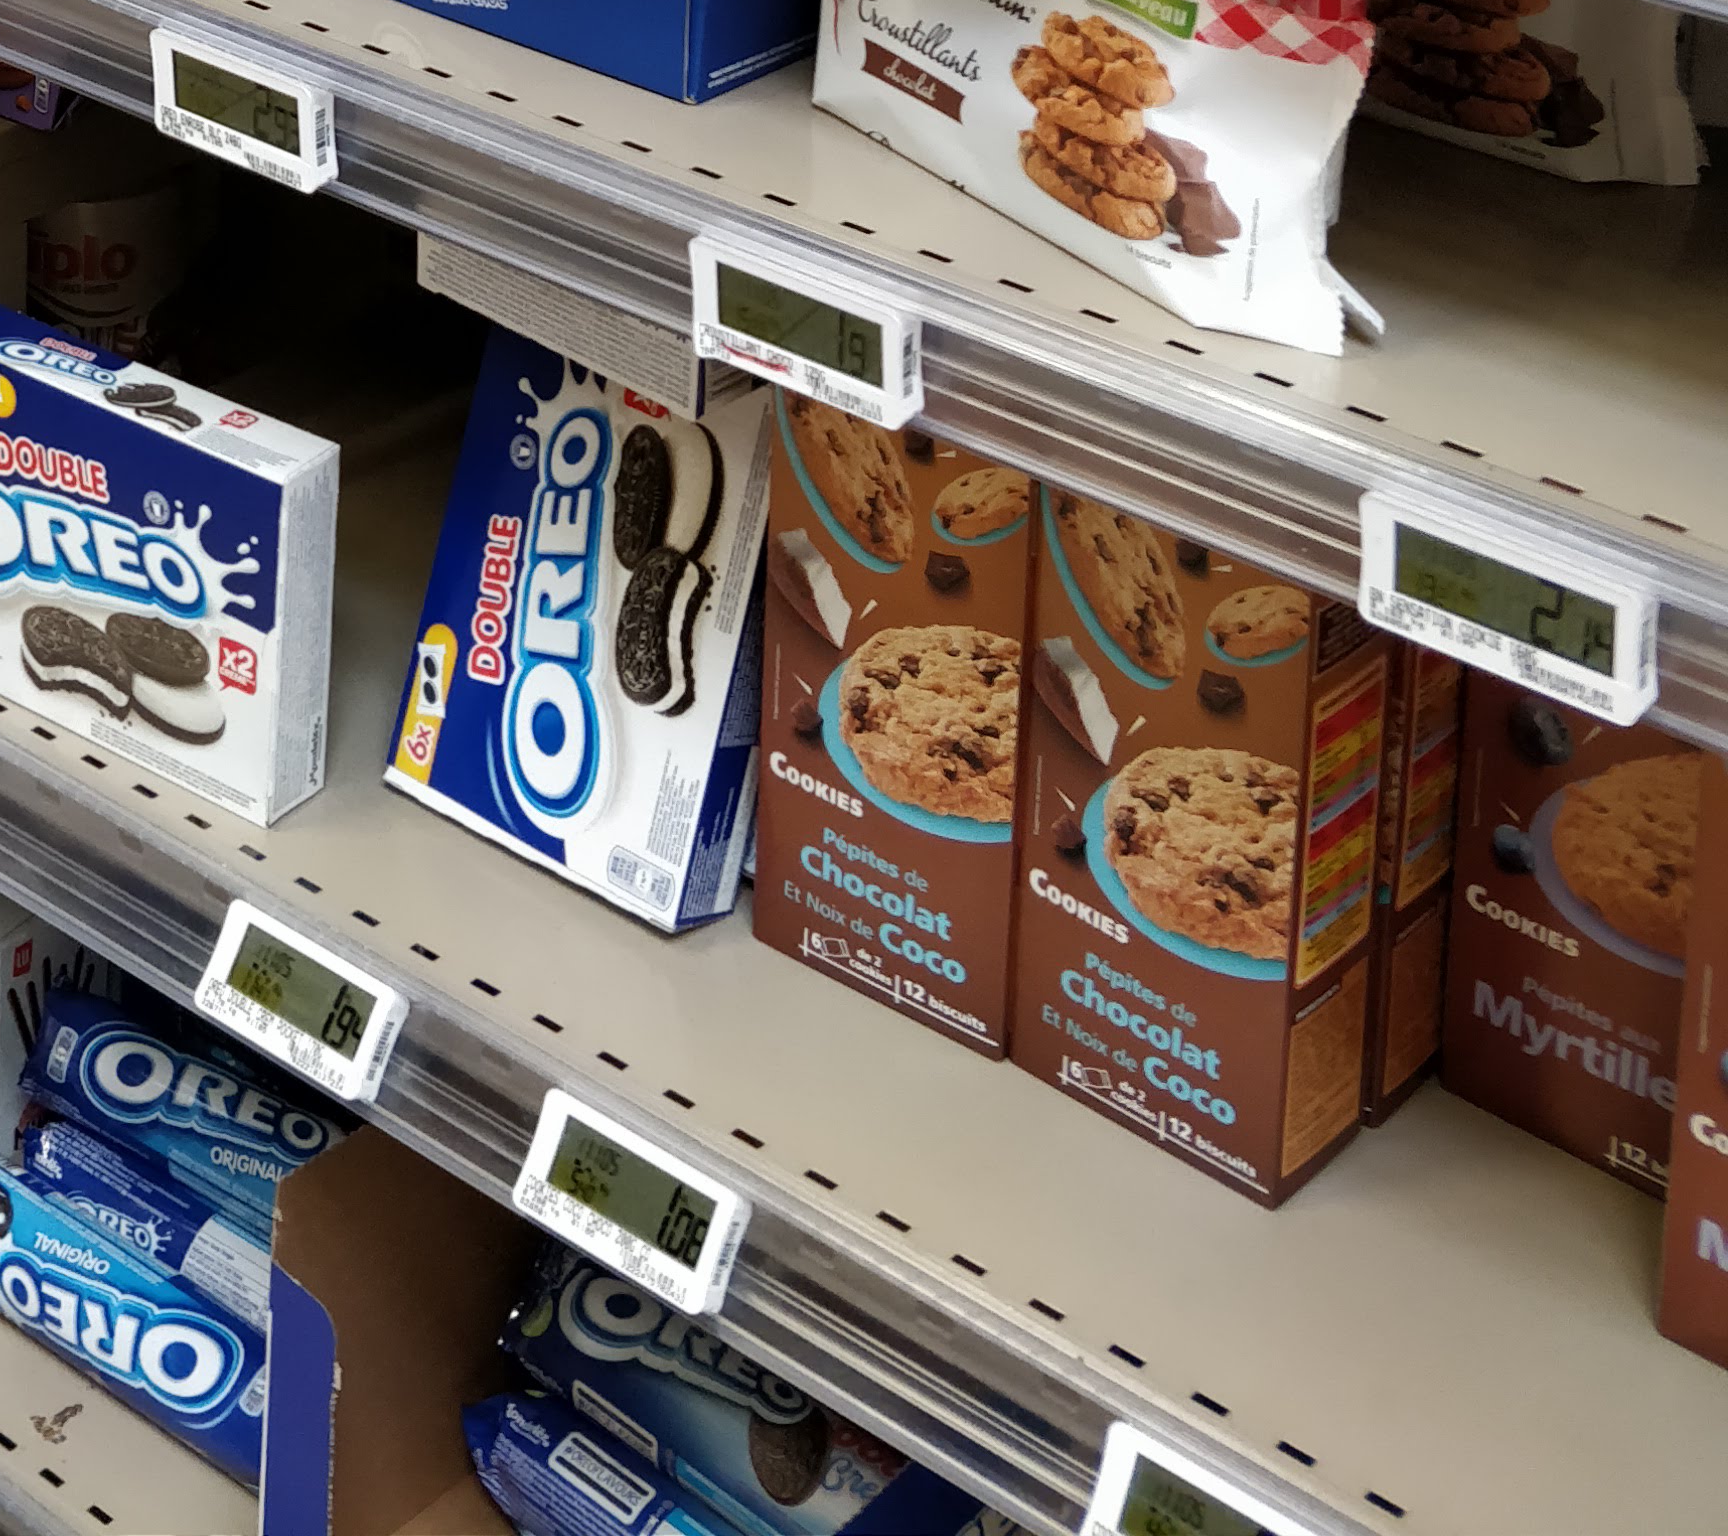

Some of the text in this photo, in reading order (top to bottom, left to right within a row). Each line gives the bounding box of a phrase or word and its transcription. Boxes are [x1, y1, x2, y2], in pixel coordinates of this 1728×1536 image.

[467, 514, 520, 686] DOUBLE
[513, 414, 602, 802] OREO
[406, 722, 433, 762] 6x
[800, 843, 952, 944] Chocolat
[822, 824, 930, 894] Pépites de
[782, 879, 968, 986] Et Noix de Coco
[1059, 967, 1223, 1083] Chocolat
[94, 1039, 324, 1151] OREO
[1142, 1054, 1238, 1127] Coco
